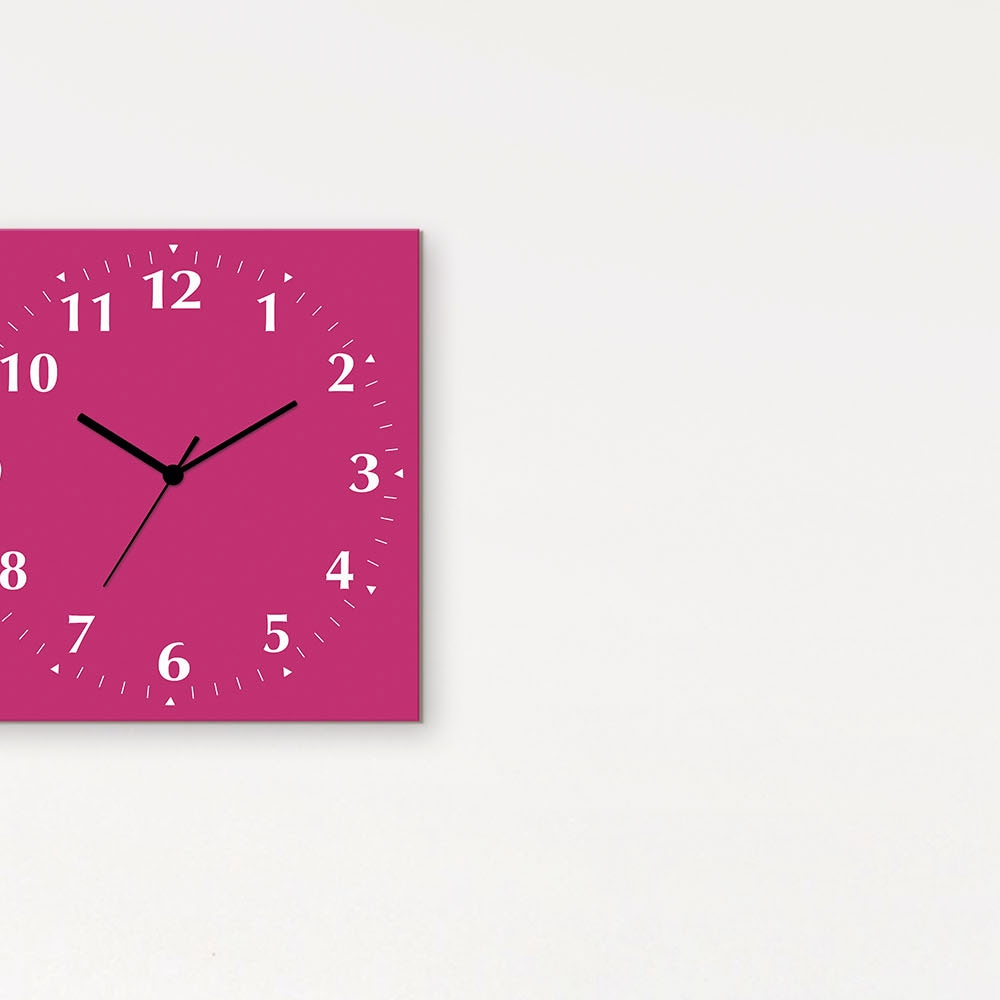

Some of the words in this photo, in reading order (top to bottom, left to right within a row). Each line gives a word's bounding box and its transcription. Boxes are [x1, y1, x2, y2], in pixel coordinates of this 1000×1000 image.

[142, 269, 201, 309] 12
[60, 292, 111, 332] 11
[256, 292, 276, 332] 1
[0, 352, 58, 393] 10
[327, 352, 354, 392] 2
[348, 453, 380, 493] 3
[325, 550, 354, 590] 4
[67, 614, 96, 654] 7
[263, 613, 290, 654] 5
[157, 641, 191, 682] 6
